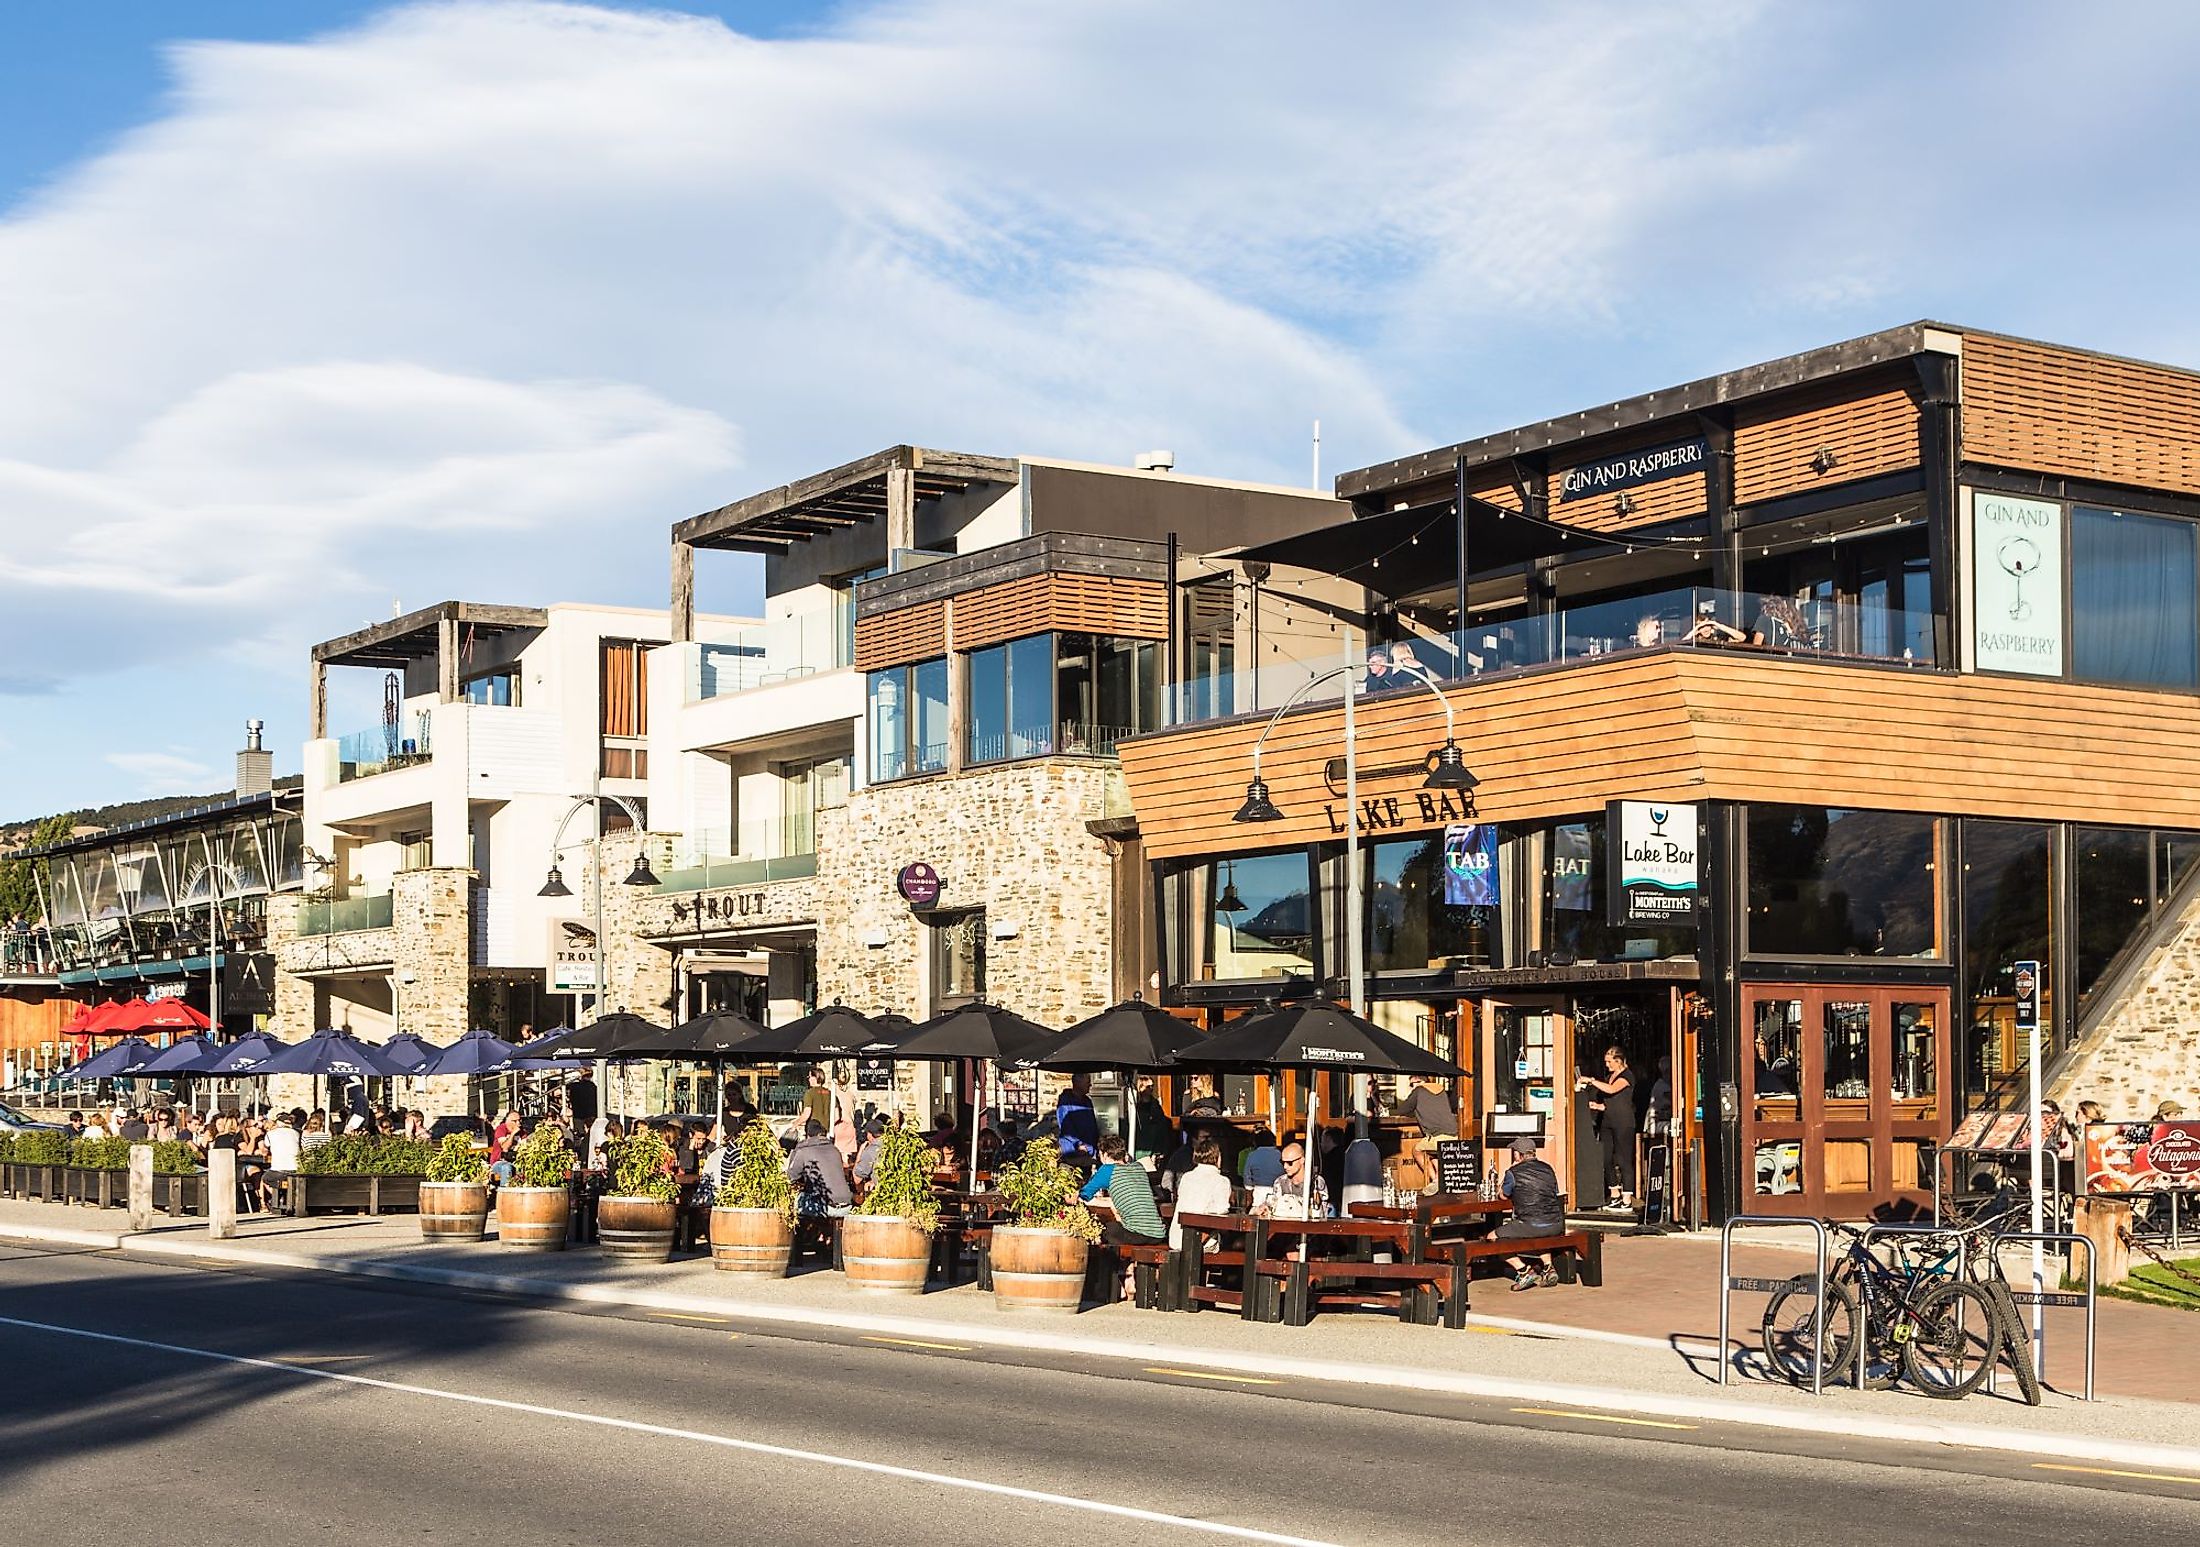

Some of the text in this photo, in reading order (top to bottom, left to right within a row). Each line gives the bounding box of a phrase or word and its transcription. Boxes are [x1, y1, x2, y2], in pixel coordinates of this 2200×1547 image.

[1565, 443, 1705, 491] GIN AND RASPBERRY
[1985, 503, 2050, 528] GIN AND
[1981, 631, 2055, 655] RASPBERRY
[1415, 788, 1479, 823] BAR
[1446, 852, 1490, 870] TAB
[1624, 840, 1695, 864] Lake Bar
[1634, 896, 1691, 910] MONTEITH'S
[1634, 911, 1662, 919] BREWING
[1651, 1176, 1663, 1192] TAB
[1737, 1279, 1758, 1290] FREE
